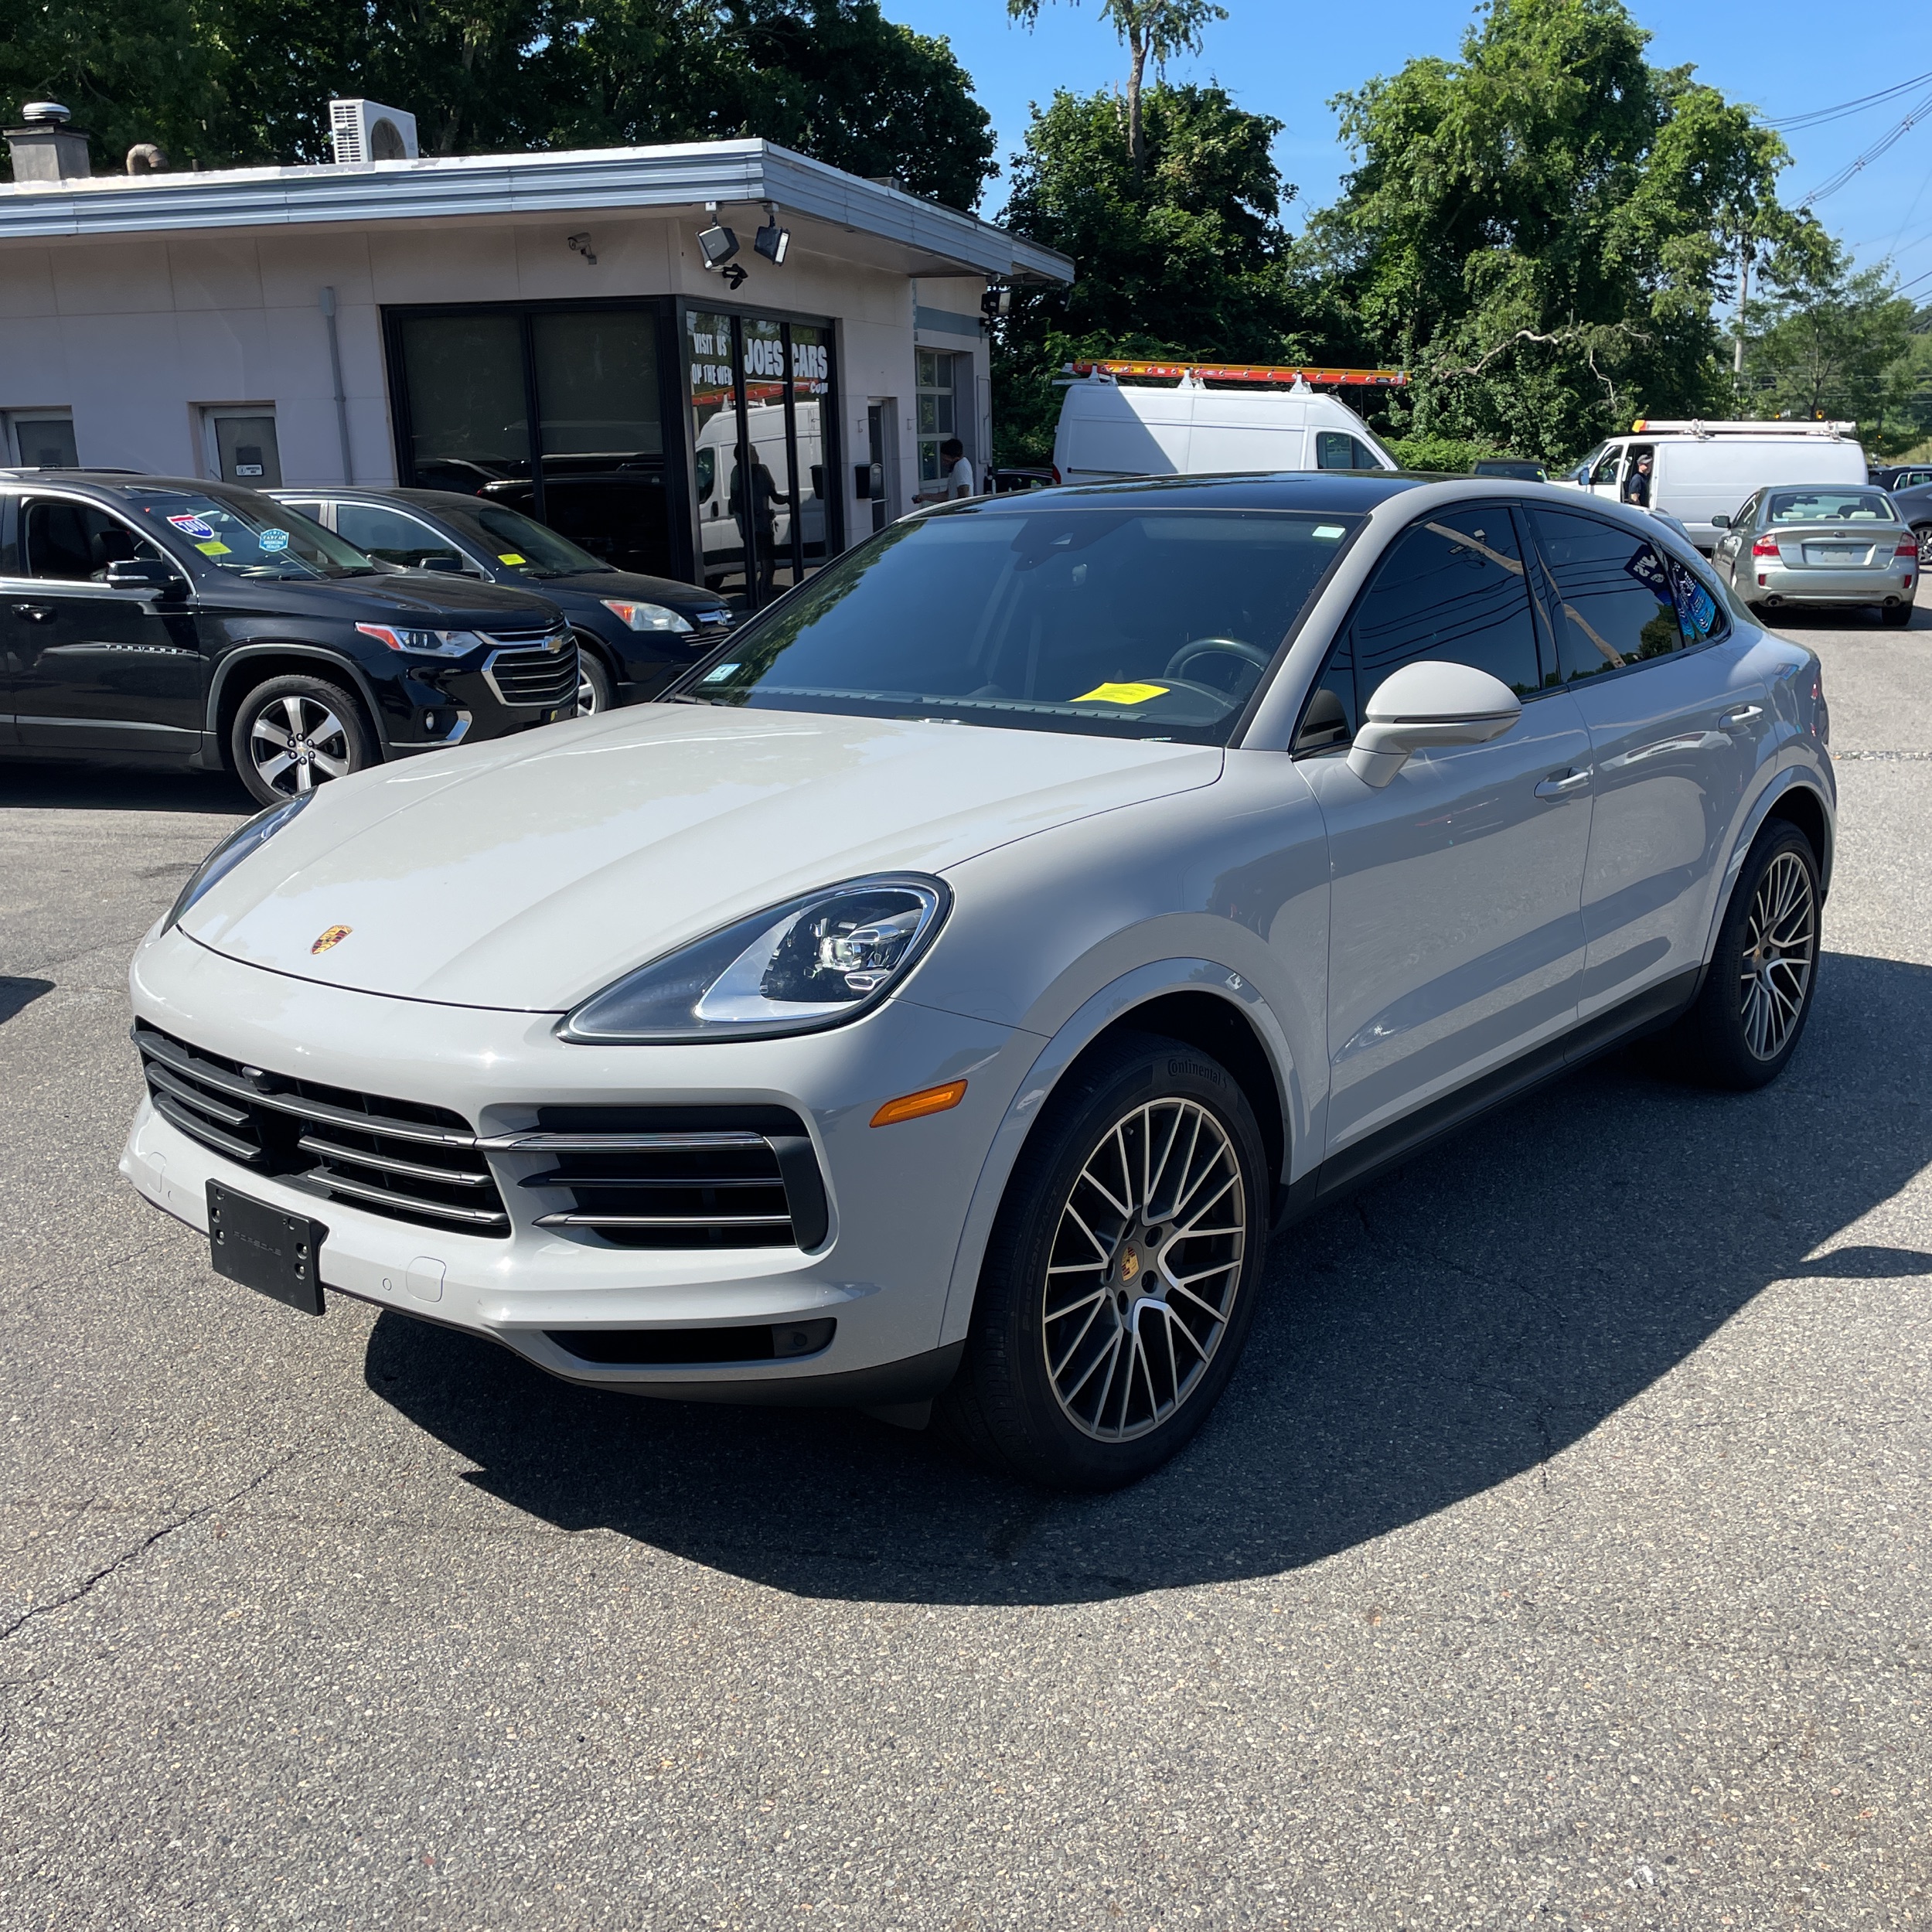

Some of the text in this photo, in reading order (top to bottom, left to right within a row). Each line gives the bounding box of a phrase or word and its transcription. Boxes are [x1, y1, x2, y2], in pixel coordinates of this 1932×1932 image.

[693, 332, 727, 356] VISIT US
[745, 338, 828, 380] JOES CARS
[703, 364, 717, 385] THE
[717, 365, 733, 386] WEB
[178, 520, 210, 533] 2018
[1167, 1058, 1222, 1085] Continental
[233, 1230, 282, 1257] PORSCHE
